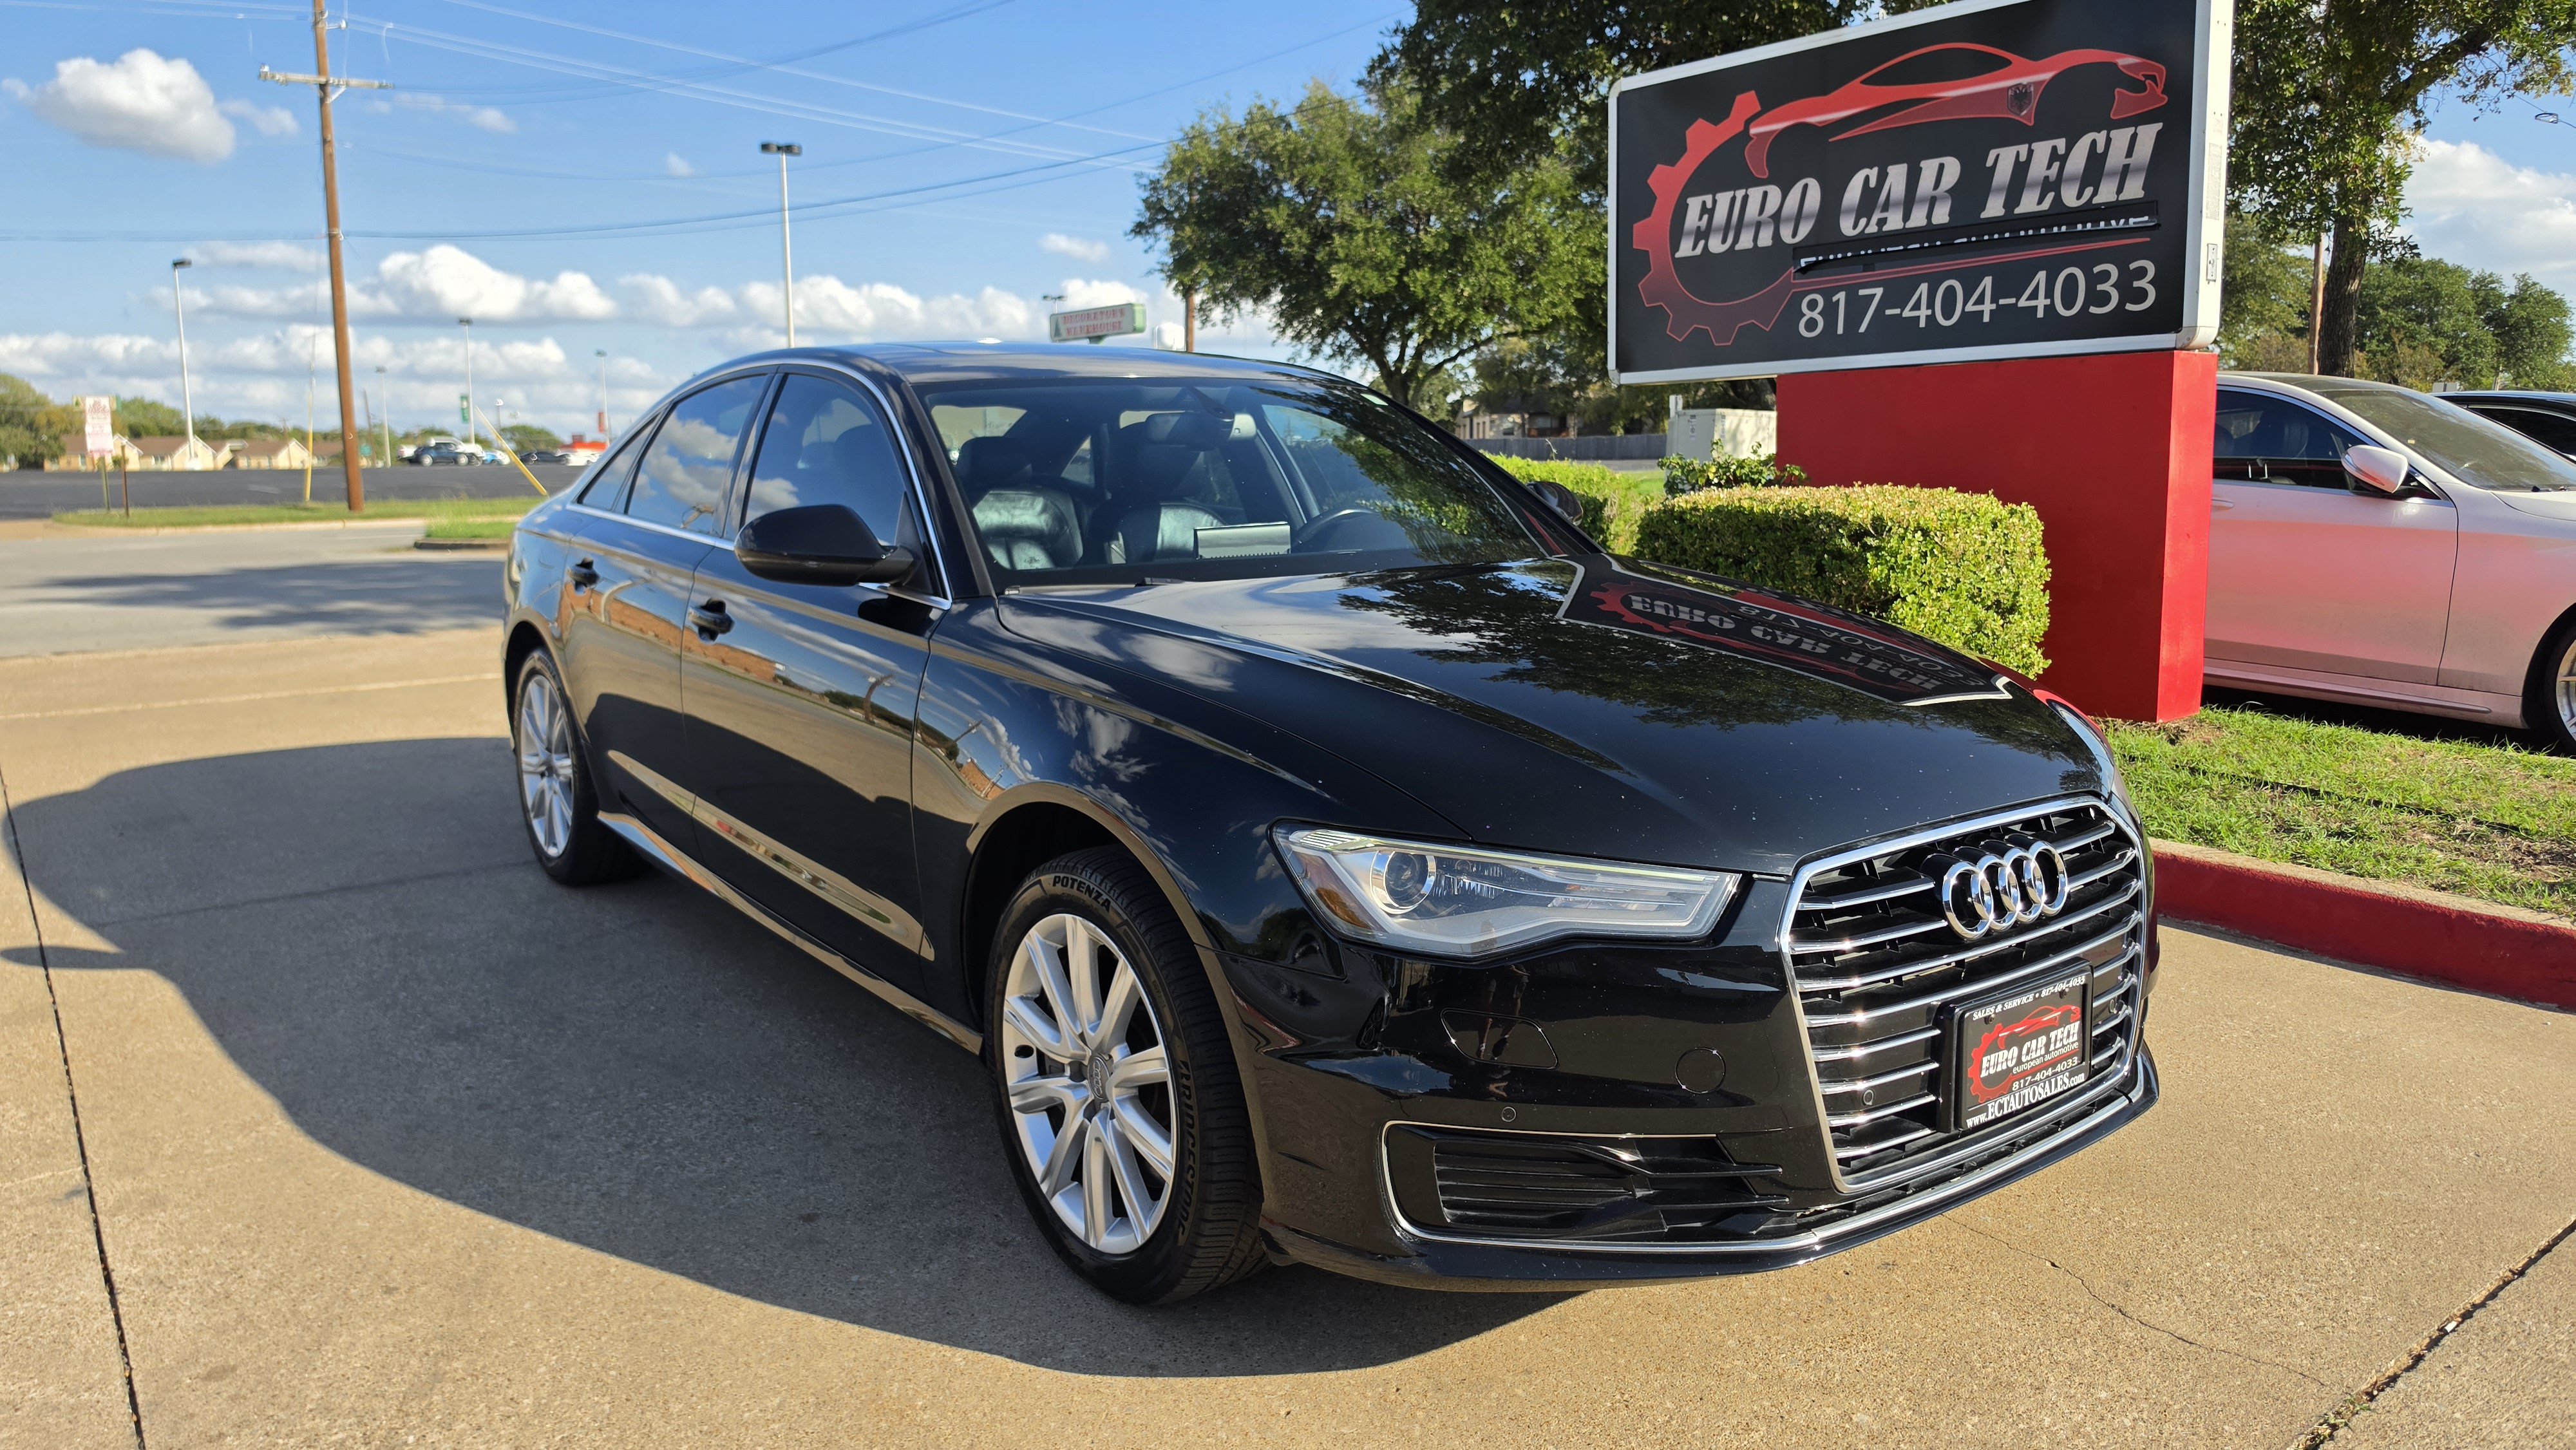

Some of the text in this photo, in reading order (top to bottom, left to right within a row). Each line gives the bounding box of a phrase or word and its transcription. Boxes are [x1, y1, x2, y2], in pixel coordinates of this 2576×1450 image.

[1674, 177, 1821, 259] EURO
[1839, 156, 1961, 238] CAR
[1980, 122, 2164, 219] TECH
[1797, 259, 2157, 339] 817-404-4033
[1052, 874, 1112, 913] POTENZA
[1972, 975, 2086, 1021] SALES & SERVICE 817-404-4033
[1980, 1021, 2080, 1078] EURO CAR TECH
[2012, 1042, 2079, 1075] european automotive
[2012, 1056, 2078, 1091] 817-404-4033
[1966, 1071, 2085, 1129] www.ECTAUTOSALES.com
